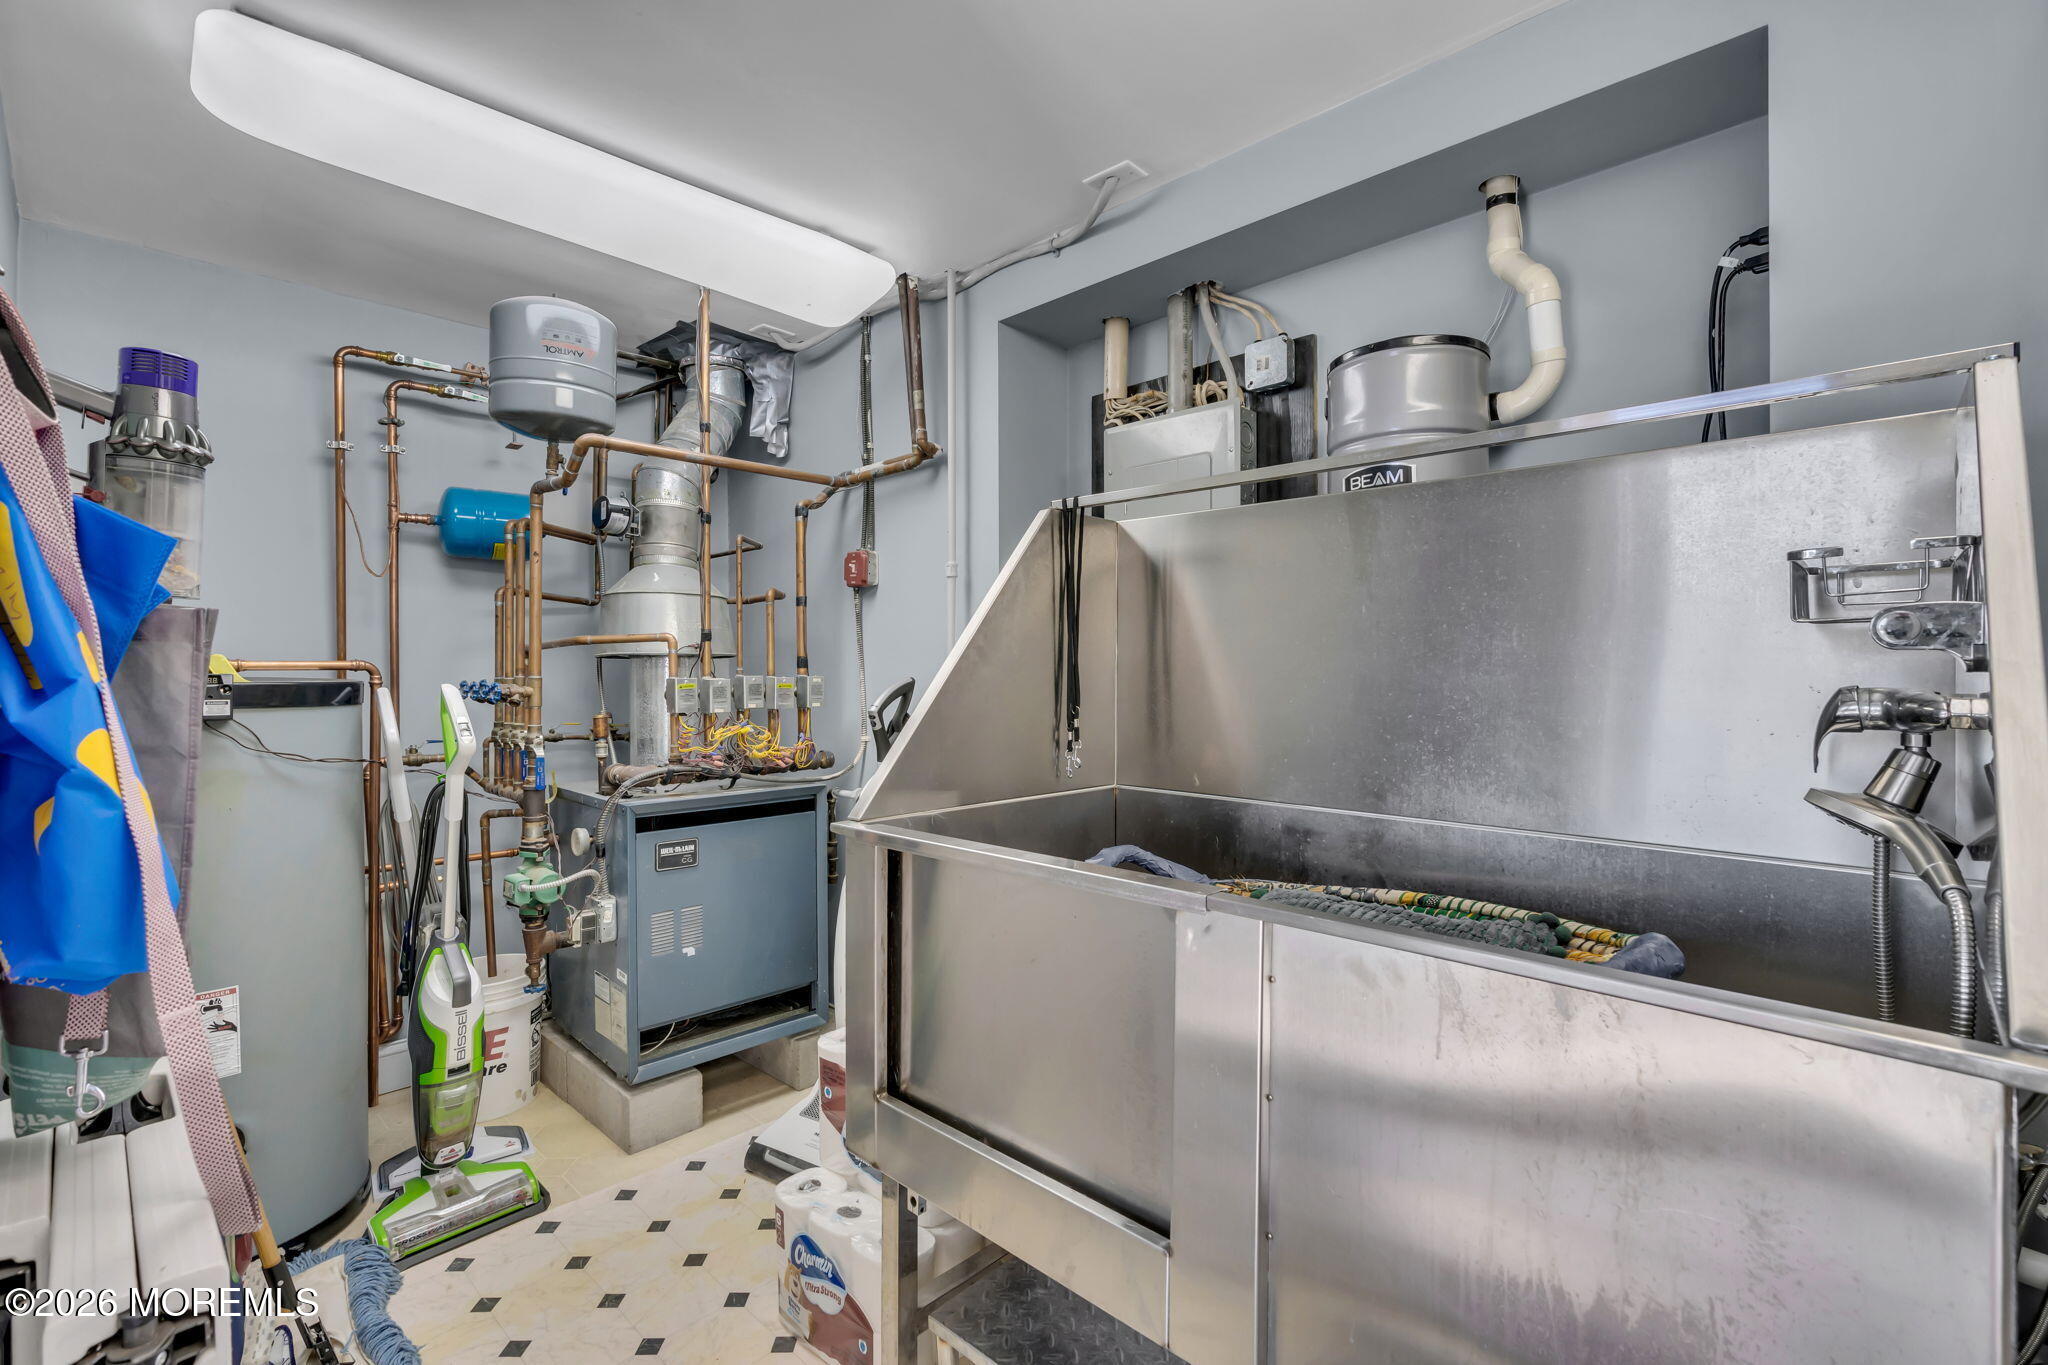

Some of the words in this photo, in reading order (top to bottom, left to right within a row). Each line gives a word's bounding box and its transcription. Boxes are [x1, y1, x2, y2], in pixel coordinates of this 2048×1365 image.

[543, 344, 585, 358] AMTROL
[1350, 468, 1404, 491] BEAM
[200, 990, 231, 1000] DANGER
[794, 1244, 834, 1278] Charmin
[820, 1285, 842, 1305] Strong
